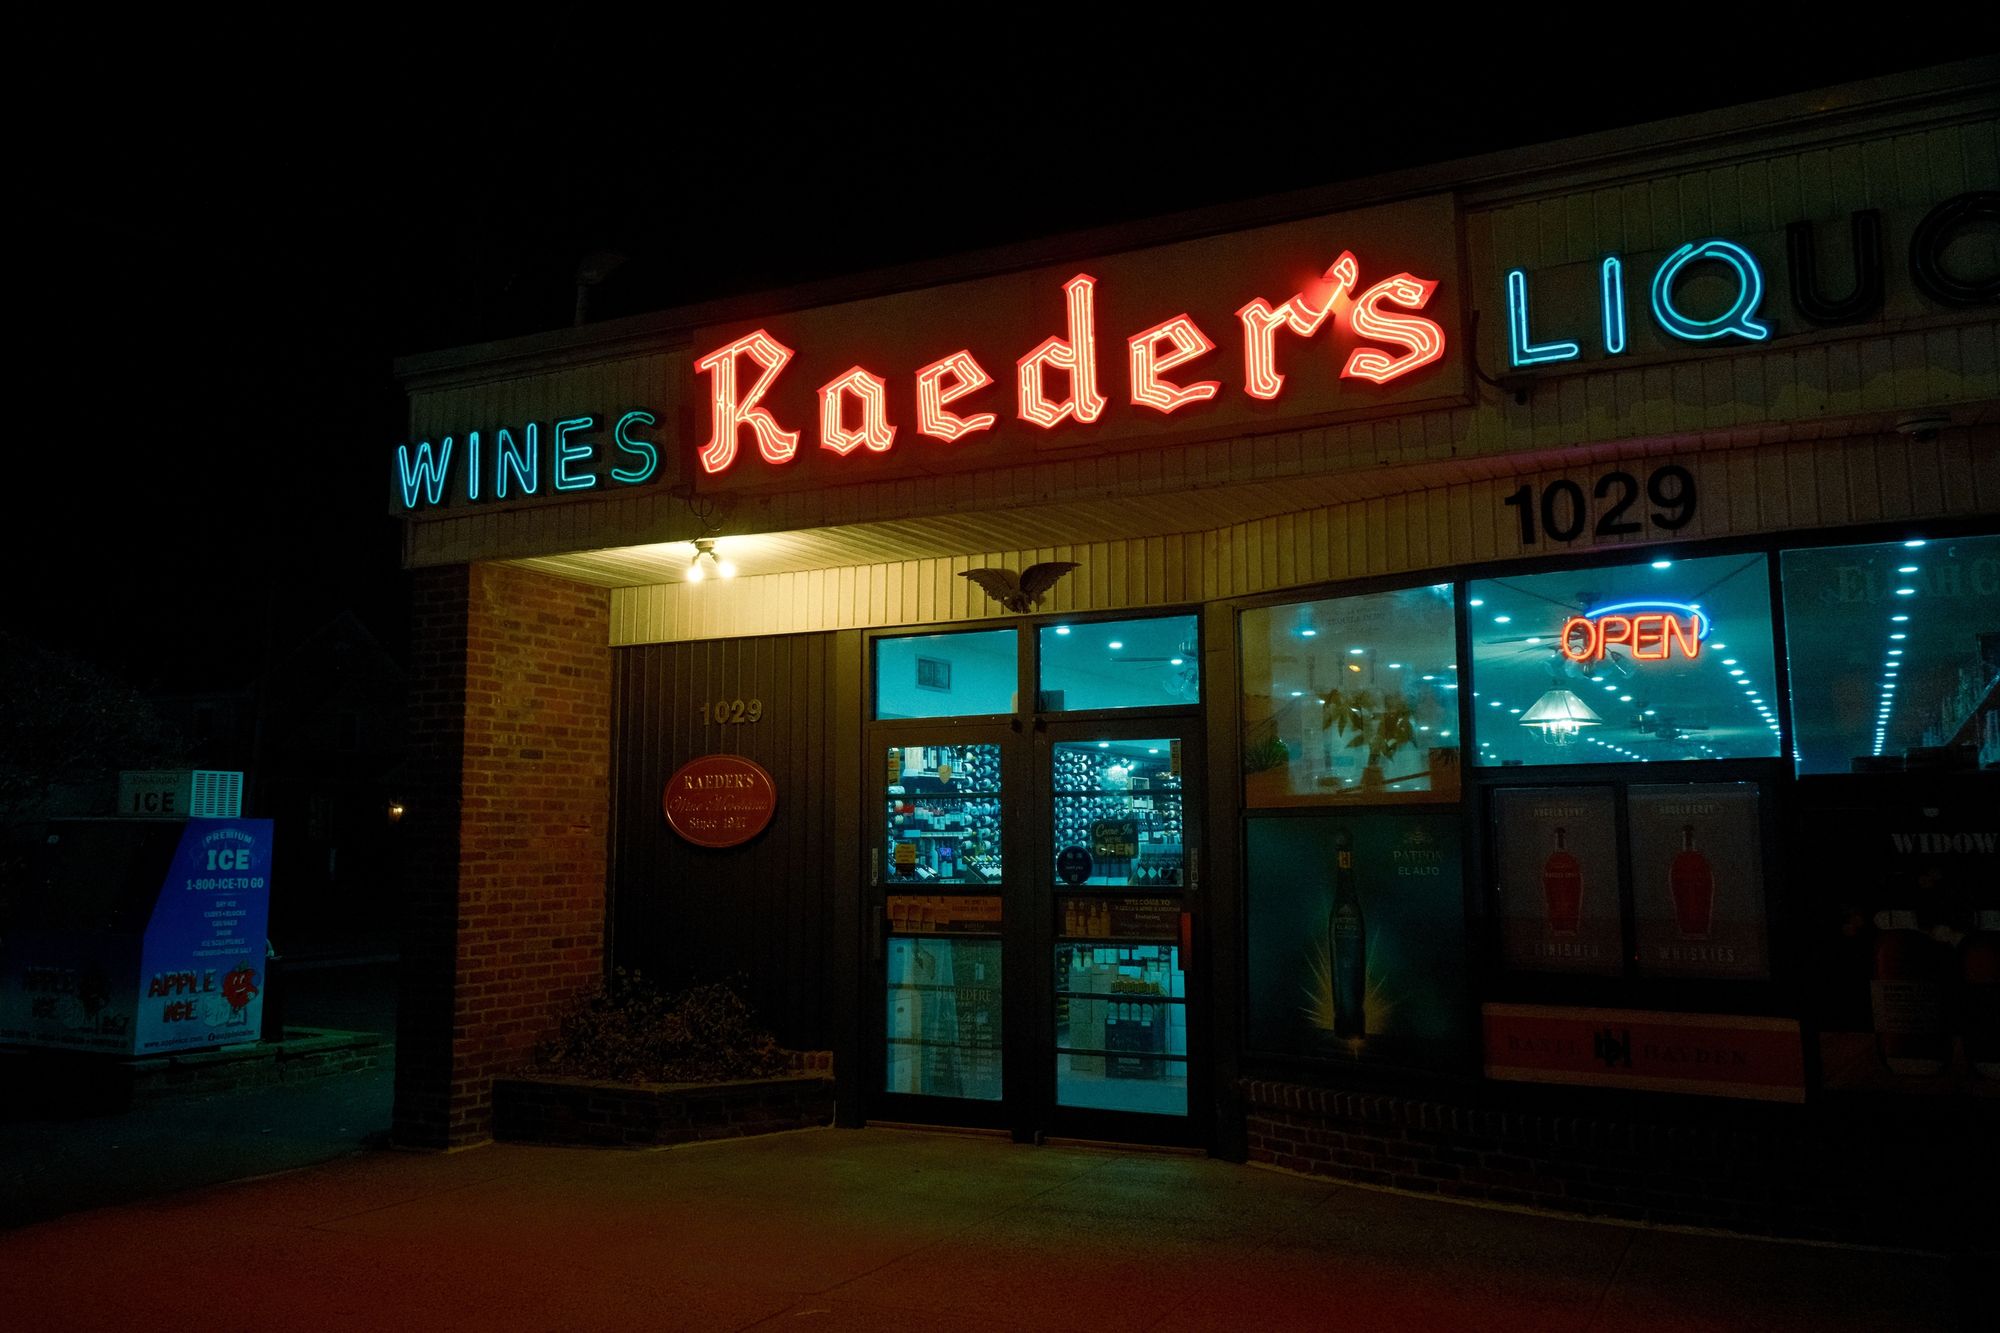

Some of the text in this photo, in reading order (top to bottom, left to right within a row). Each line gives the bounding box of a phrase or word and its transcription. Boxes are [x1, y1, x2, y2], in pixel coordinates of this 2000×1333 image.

[694, 249, 1446, 474] Raeder's
[395, 408, 662, 511] WINES
[1504, 465, 1697, 545] 1029
[1561, 612, 1701, 662] OPEN
[700, 698, 763, 726] 1029
[684, 773, 755, 790] RAEDER'S
[133, 790, 176, 812] ICE
[205, 831, 253, 844] PREMIUM
[1095, 822, 1119, 838] Come
[1095, 842, 1135, 856] OPEN
[1890, 832, 1999, 854] WIDOW
[206, 848, 250, 871] ICE
[250, 876, 264, 888] GO
[1658, 945, 1735, 962] WHISKIES
[148, 968, 217, 998] APPLE
[162, 997, 199, 1024] ICE
[1643, 1043, 1748, 1065] HAYDEN
